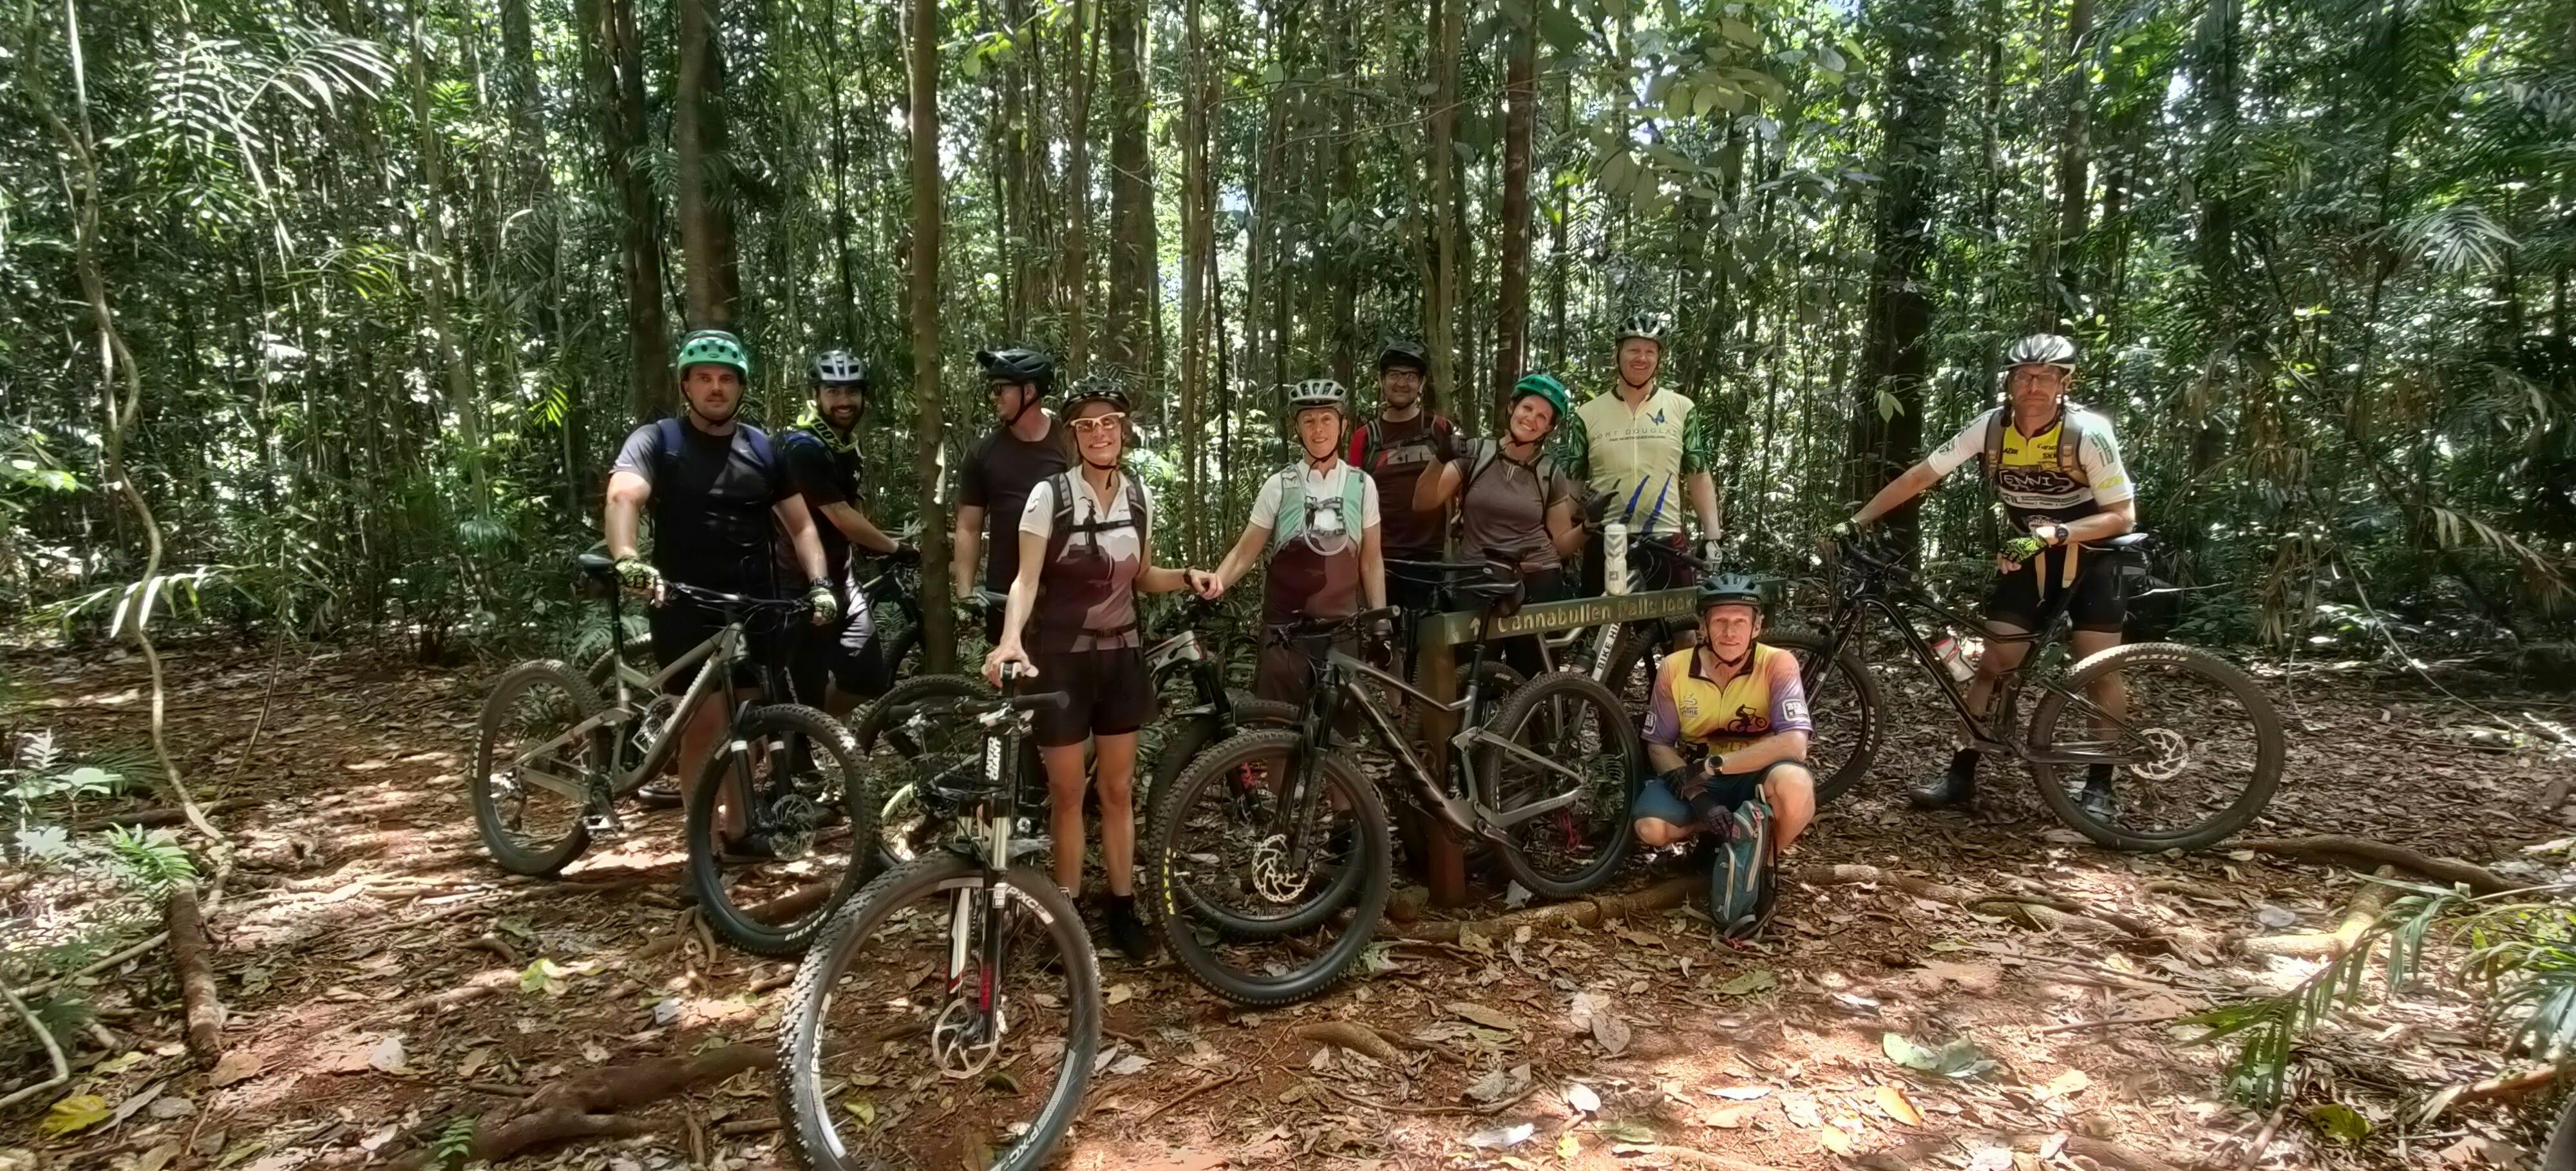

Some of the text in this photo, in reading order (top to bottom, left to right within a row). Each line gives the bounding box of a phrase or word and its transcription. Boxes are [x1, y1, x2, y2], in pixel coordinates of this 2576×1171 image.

[1498, 602, 1610, 633] Cannabullen
[1597, 642, 1613, 670] BIKE
[985, 736, 998, 780] GIANT
